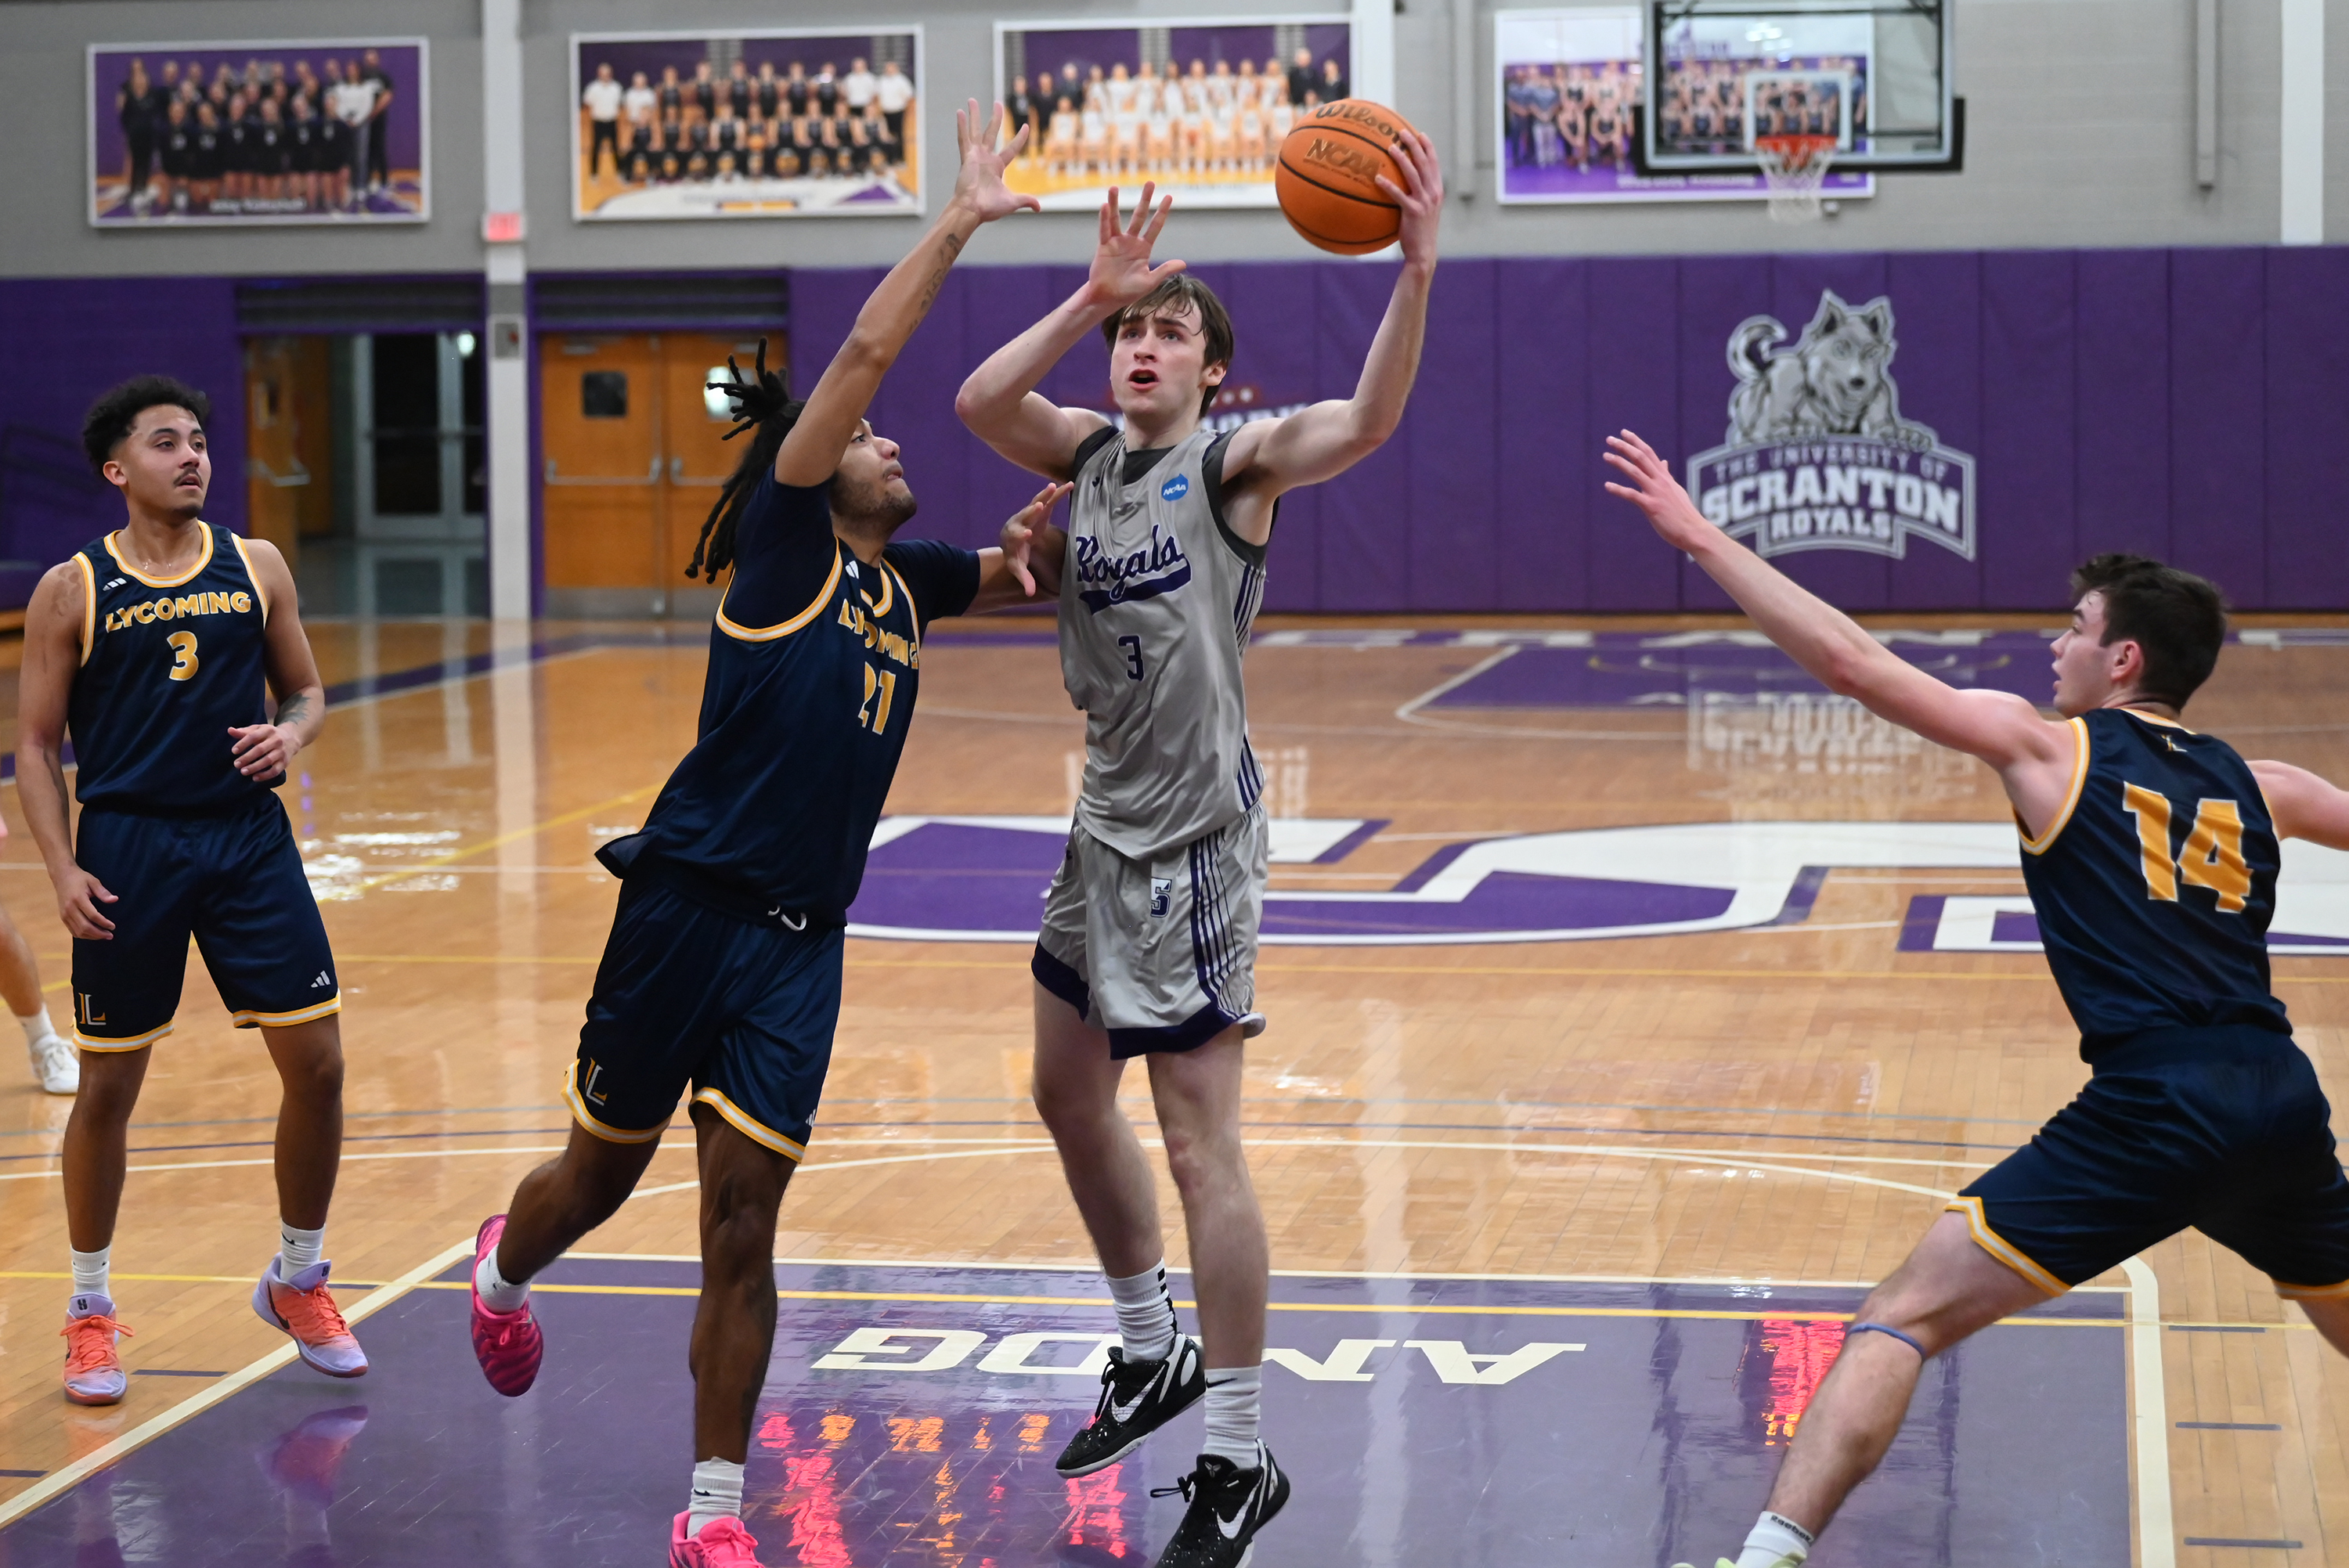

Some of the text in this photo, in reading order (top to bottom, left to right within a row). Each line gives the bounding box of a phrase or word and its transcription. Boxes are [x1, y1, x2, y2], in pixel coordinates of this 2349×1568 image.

[1714, 443, 1949, 483] THE UNIVERSITY OF
[1163, 484, 1187, 496] NCAA
[1701, 464, 1960, 533] SCRANTON
[1770, 506, 1892, 539] ROYALS
[1076, 524, 1191, 601] Royals
[105, 592, 251, 633] LYCOMING
[167, 631, 199, 681] 3
[1118, 635, 1145, 681] 3
[2122, 780, 2254, 914] 14
